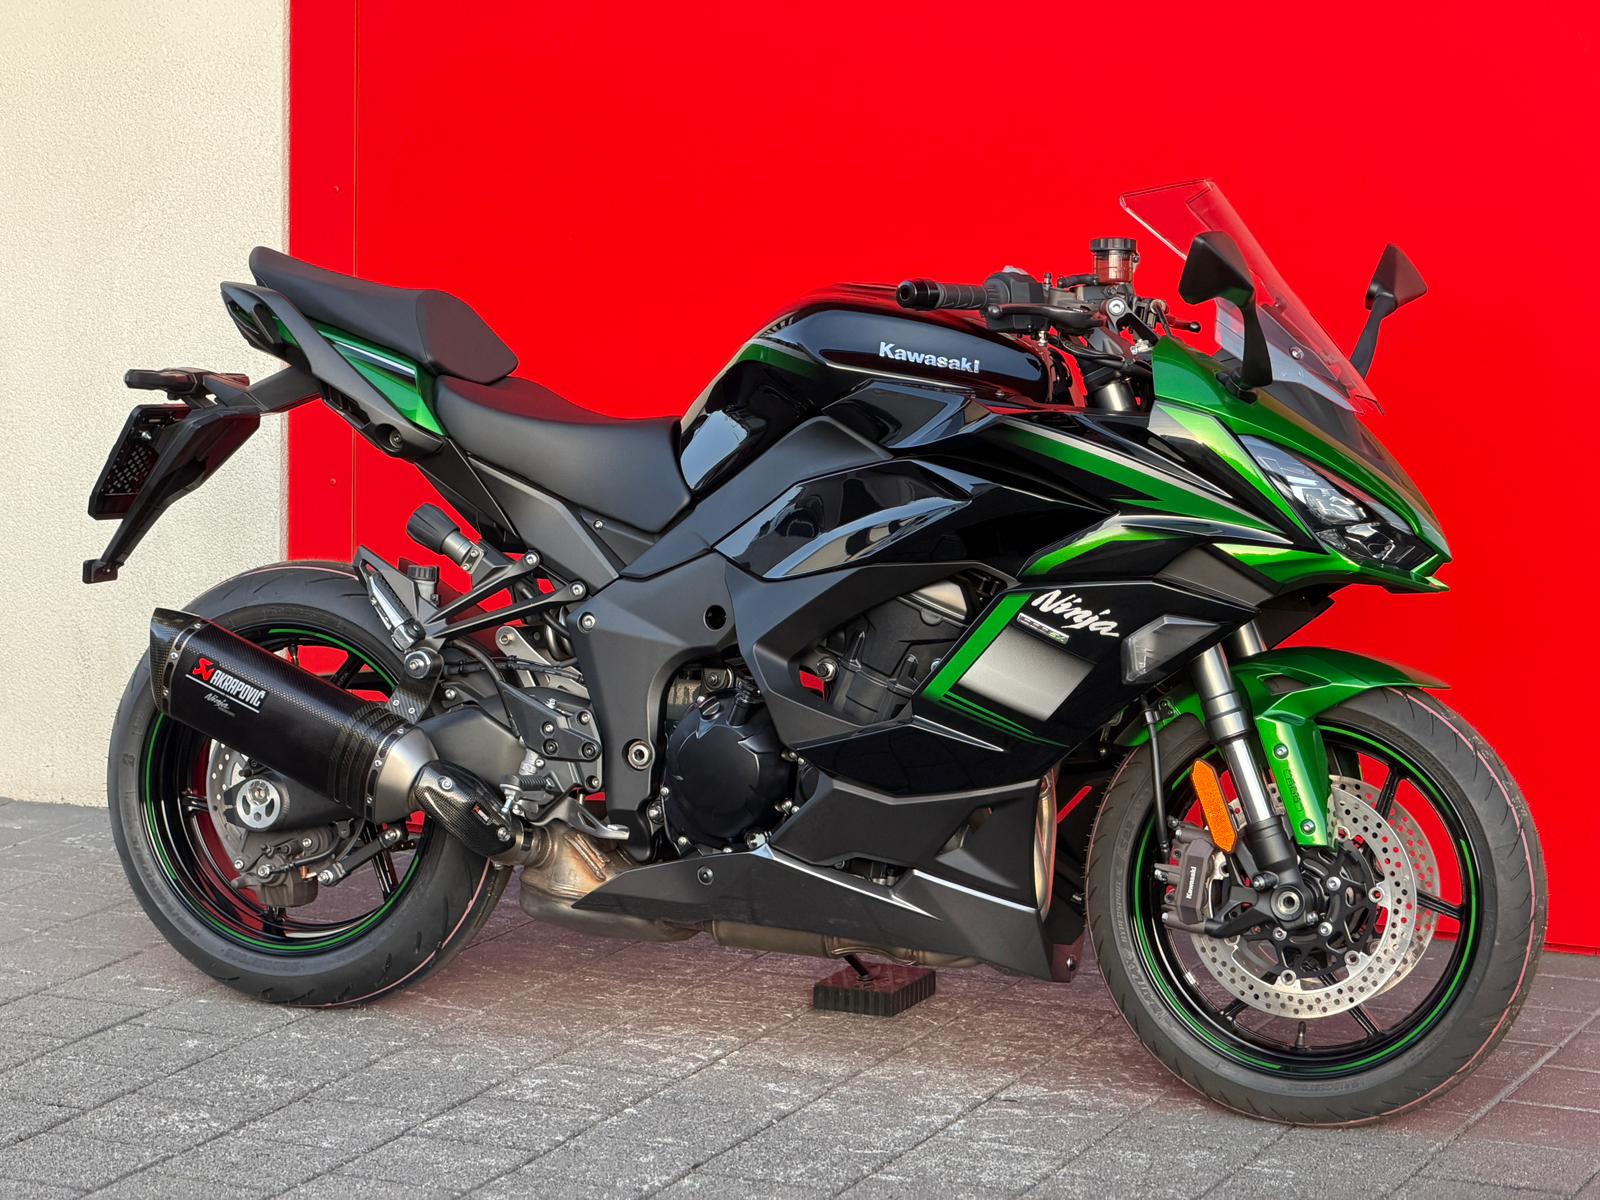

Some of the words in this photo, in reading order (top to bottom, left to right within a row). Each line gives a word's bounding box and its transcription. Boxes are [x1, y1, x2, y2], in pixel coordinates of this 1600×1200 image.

[879, 341, 980, 373] Kawasaki
[1031, 589, 1120, 637] Ninja
[1186, 866, 1197, 899] Kawasaki
